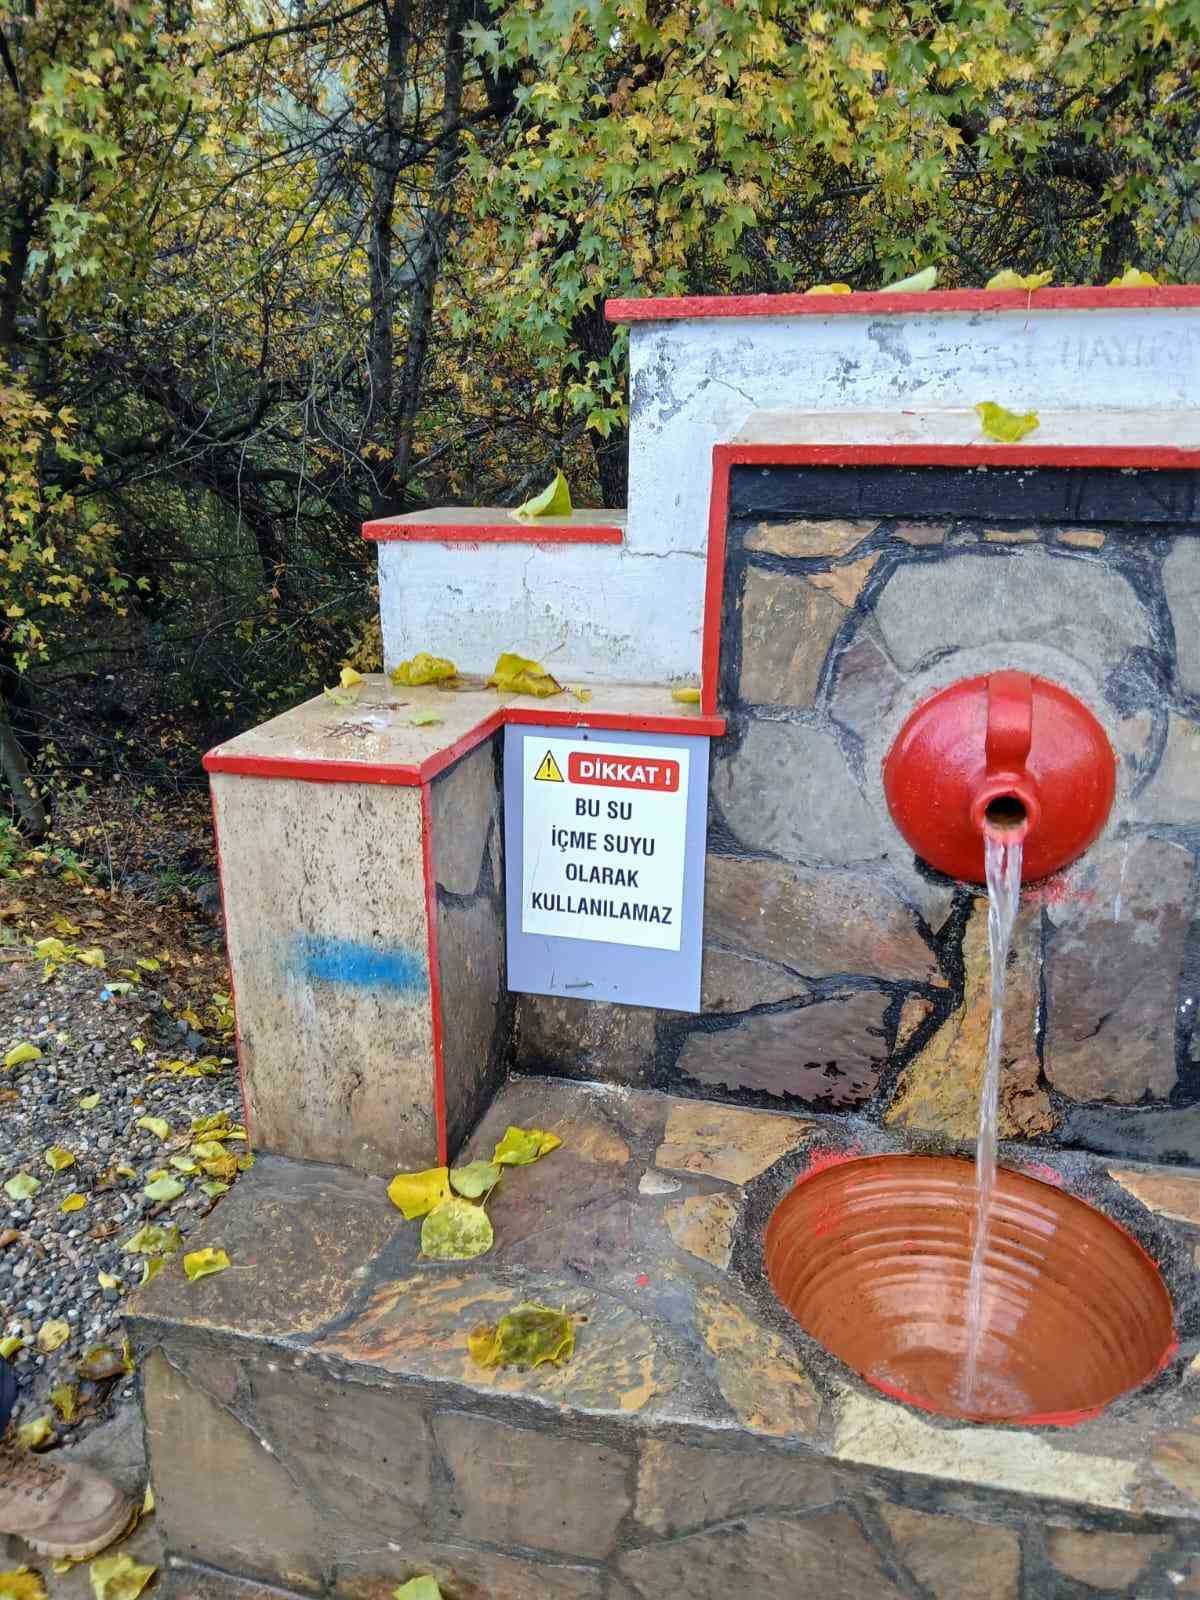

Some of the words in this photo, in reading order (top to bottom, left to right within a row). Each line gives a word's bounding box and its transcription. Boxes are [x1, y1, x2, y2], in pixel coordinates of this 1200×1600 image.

[579, 758, 659, 785] DİKKAT
[575, 797, 600, 817] BU
[607, 800, 633, 820] SU
[551, 825, 597, 853] İÇME
[603, 833, 655, 857] SUYU
[565, 863, 639, 888] OLARAK
[531, 891, 673, 925] KULLANILAMAZ
